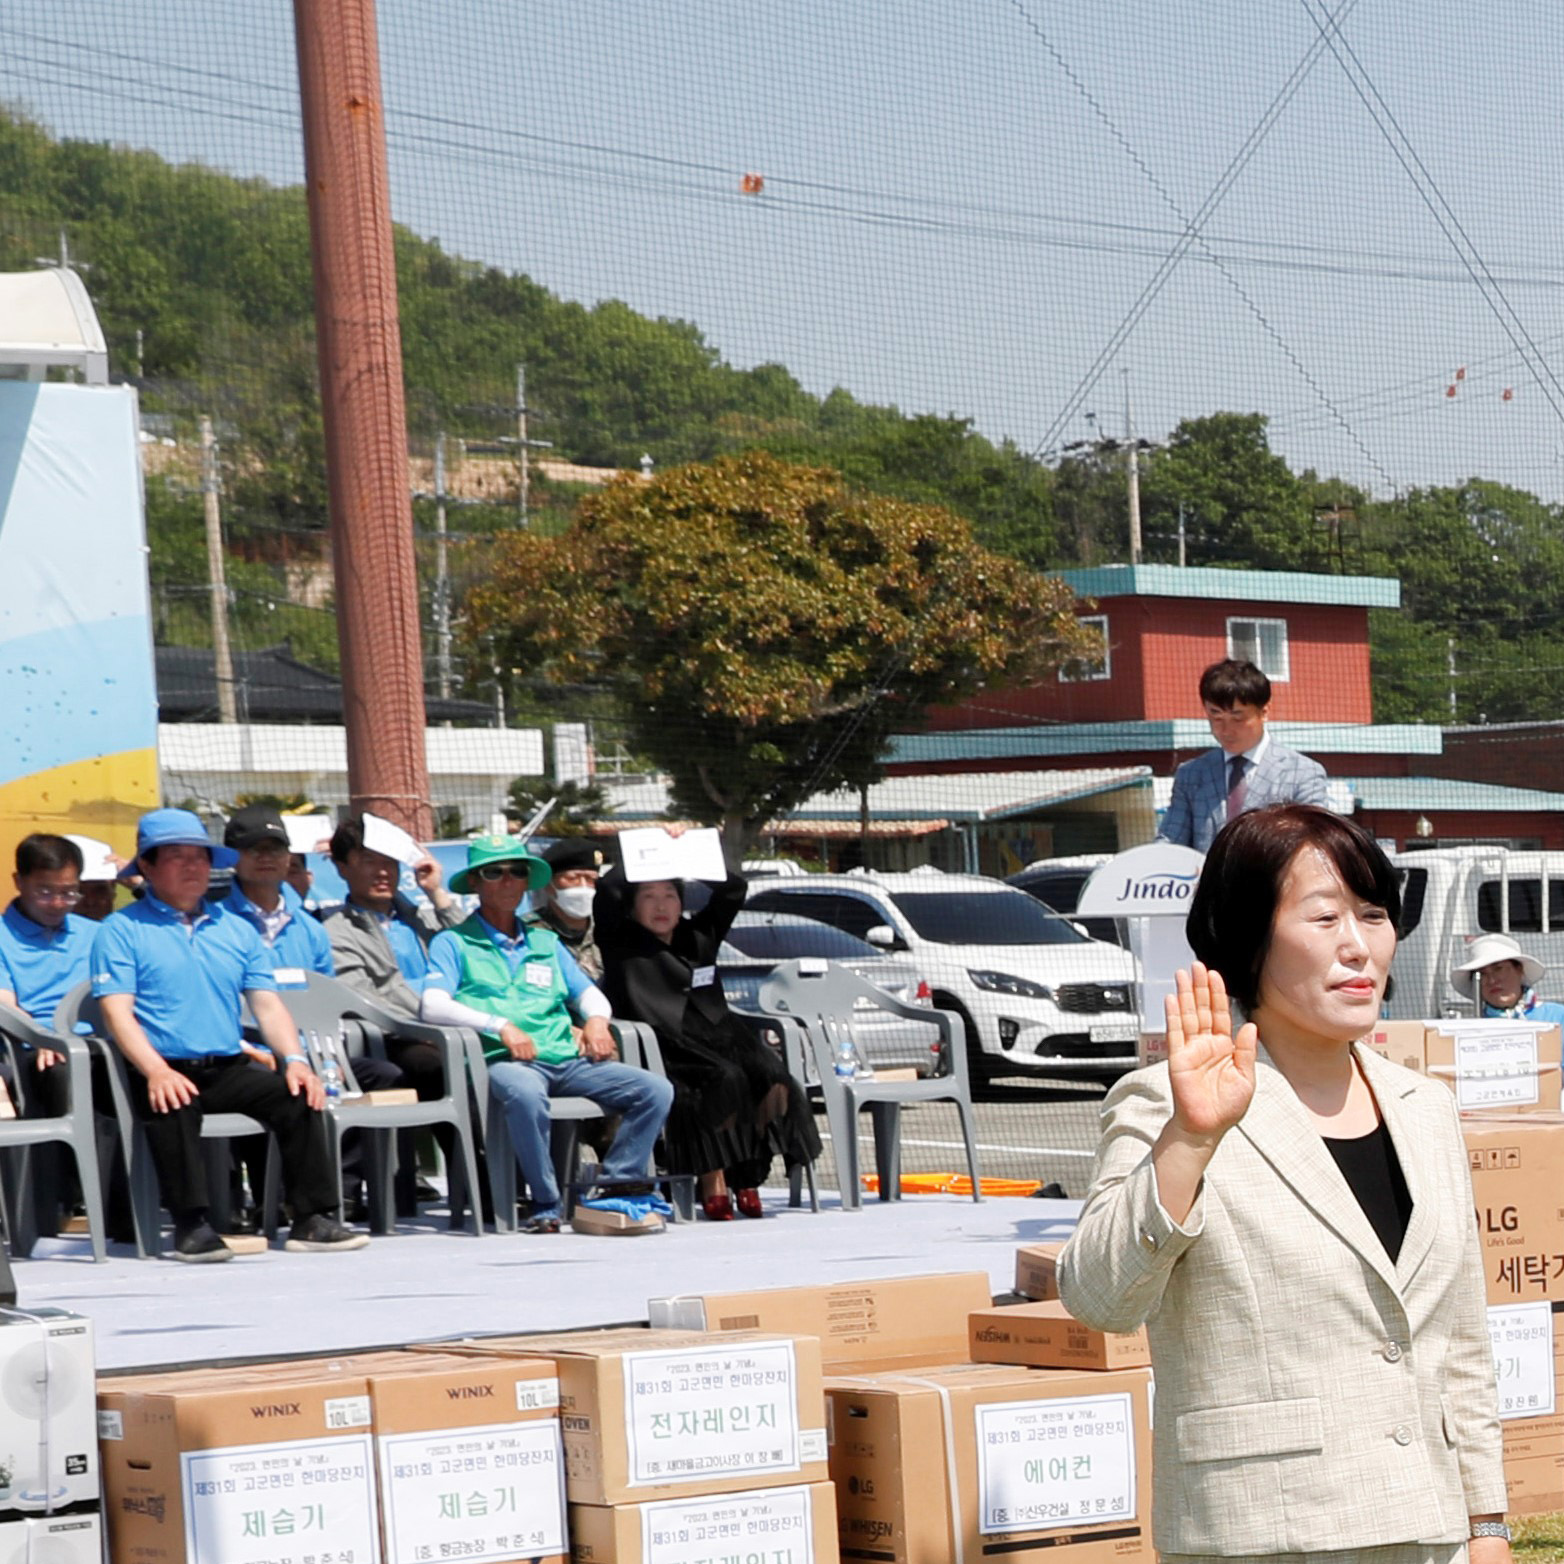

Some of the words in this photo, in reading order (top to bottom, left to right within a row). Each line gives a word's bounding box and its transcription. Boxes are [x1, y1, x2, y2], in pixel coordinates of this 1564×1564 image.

[1487, 1206, 1518, 1232] LG
[1487, 1238, 1505, 1247] Life's
[1507, 1236, 1525, 1245] Good
[447, 1384, 495, 1399] WINIX
[635, 1380, 672, 1395] 제31회
[679, 1375, 724, 1392] 고군면민
[730, 1370, 787, 1388] 한마당잔치
[250, 1403, 302, 1419] WINIX
[565, 1417, 590, 1429] OVEN
[650, 1403, 777, 1439] 전자레인지
[1026, 1425, 1068, 1441] 고군면민
[1073, 1421, 1125, 1437] 한마당잔치
[393, 1462, 432, 1479] 제31회
[439, 1456, 487, 1474] 고군면민
[494, 1449, 554, 1469] 한마당잔치
[1024, 1455, 1092, 1484] 에어컨
[194, 1479, 236, 1496] 제31회
[244, 1472, 294, 1491] 고군면민
[301, 1465, 365, 1486] 한마당잔치
[860, 1480, 873, 1494] LG
[438, 1486, 516, 1519] 제습기
[241, 1503, 324, 1538] 제습기
[652, 1529, 689, 1545] 제31회
[695, 1523, 741, 1541] 고군면민
[747, 1516, 803, 1534] 한마당잔치
